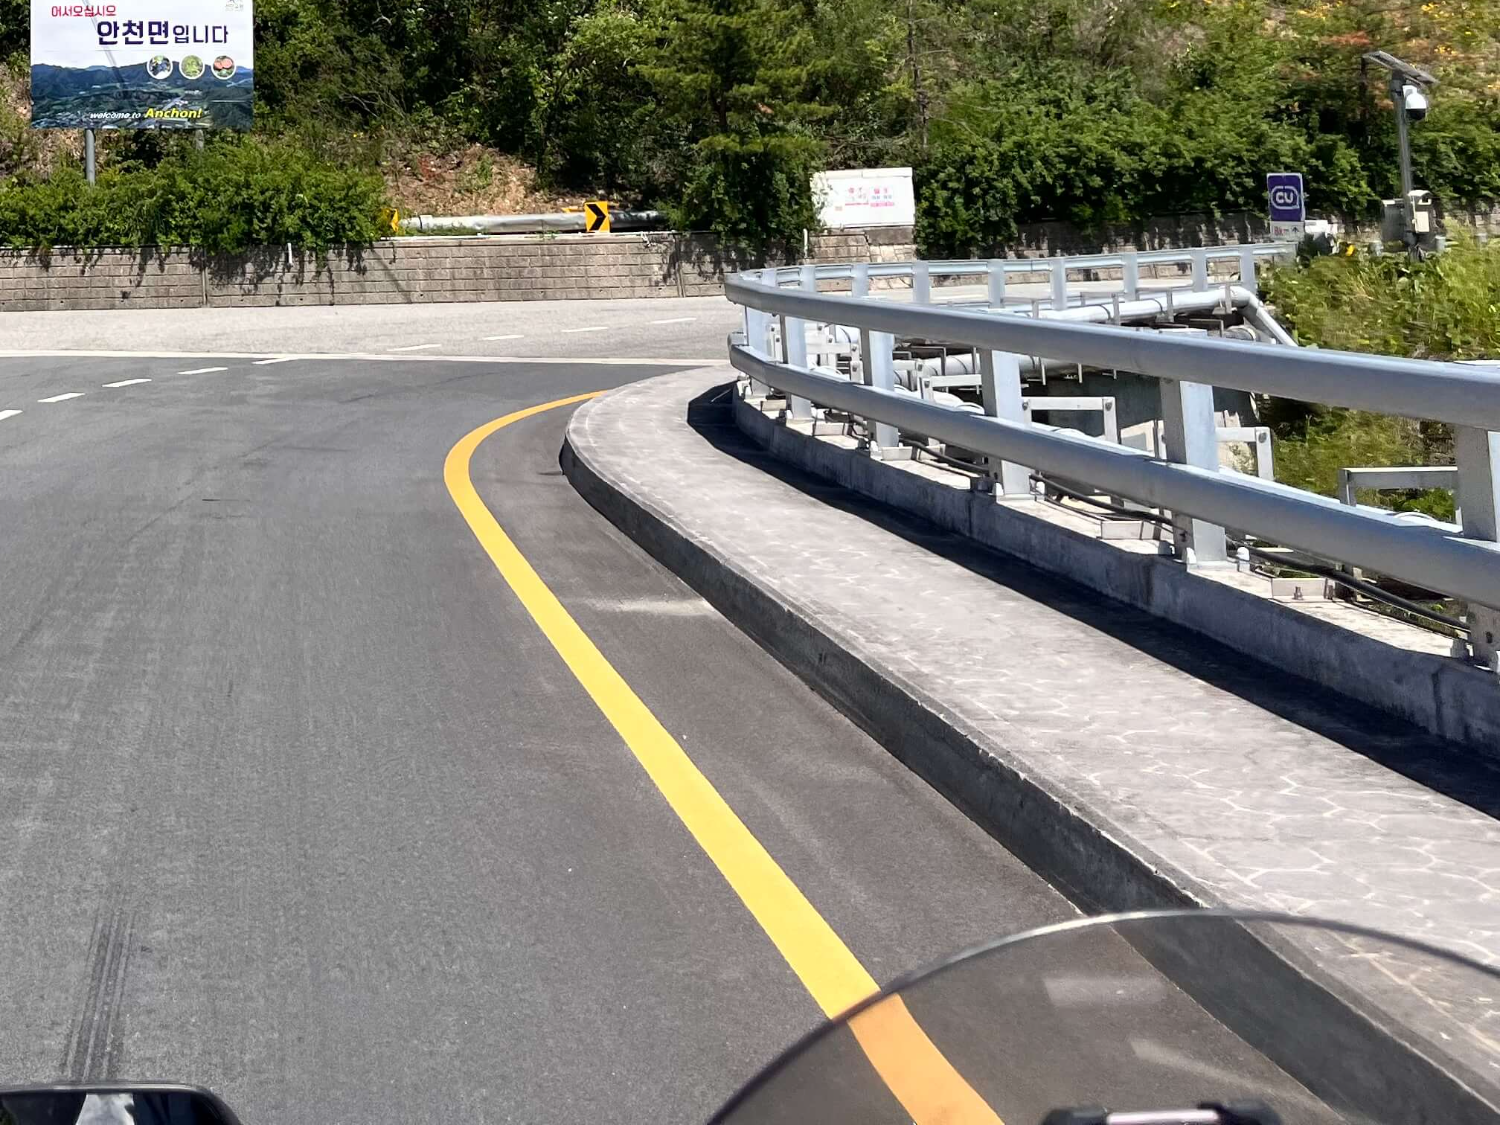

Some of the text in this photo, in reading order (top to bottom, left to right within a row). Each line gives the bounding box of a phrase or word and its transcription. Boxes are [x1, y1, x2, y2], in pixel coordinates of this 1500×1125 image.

[51, 5, 117, 18] 어서오십시오
[96, 20, 229, 46] 안천면입니다
[144, 107, 203, 119] Anchon!
[1275, 191, 1294, 204] CU
